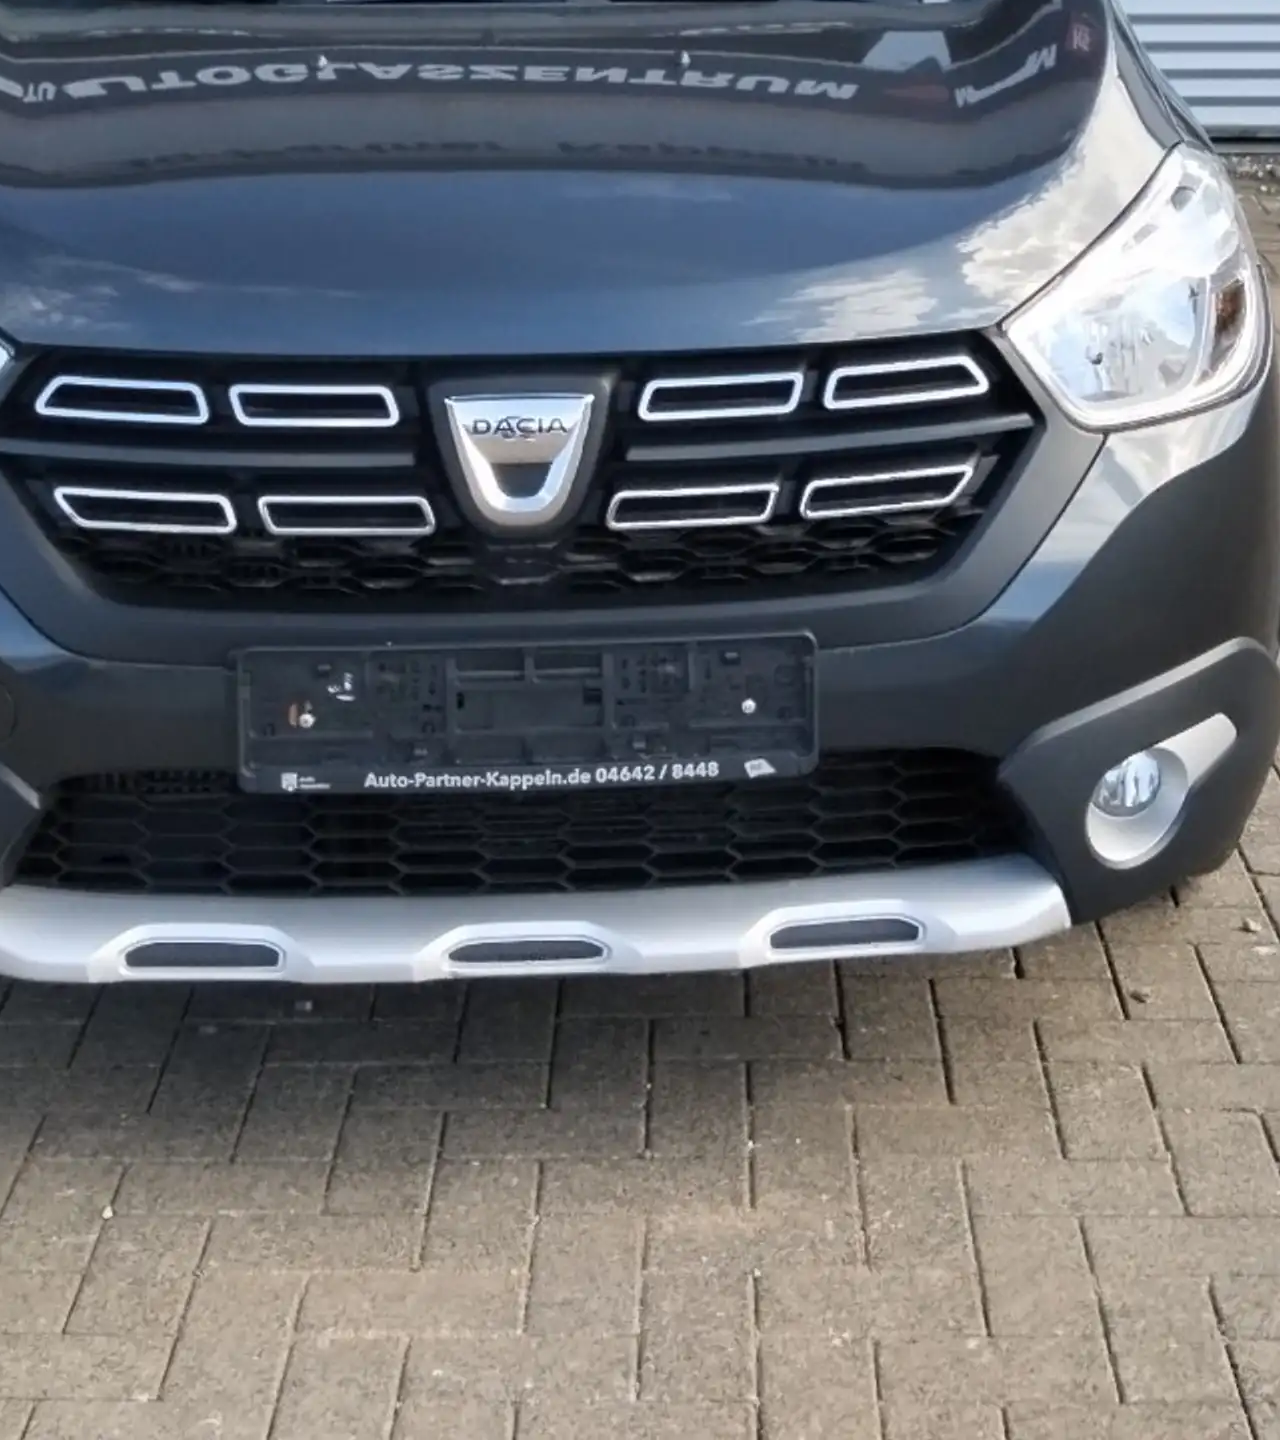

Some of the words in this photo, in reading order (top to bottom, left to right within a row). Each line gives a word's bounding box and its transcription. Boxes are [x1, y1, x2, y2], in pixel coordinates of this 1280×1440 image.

[472, 418, 569, 436] DACIA
[364, 768, 591, 791] Auto-Partner-Kappeln.de
[595, 763, 655, 783] 04642
[658, 764, 668, 780] /
[671, 761, 719, 779] 8448
